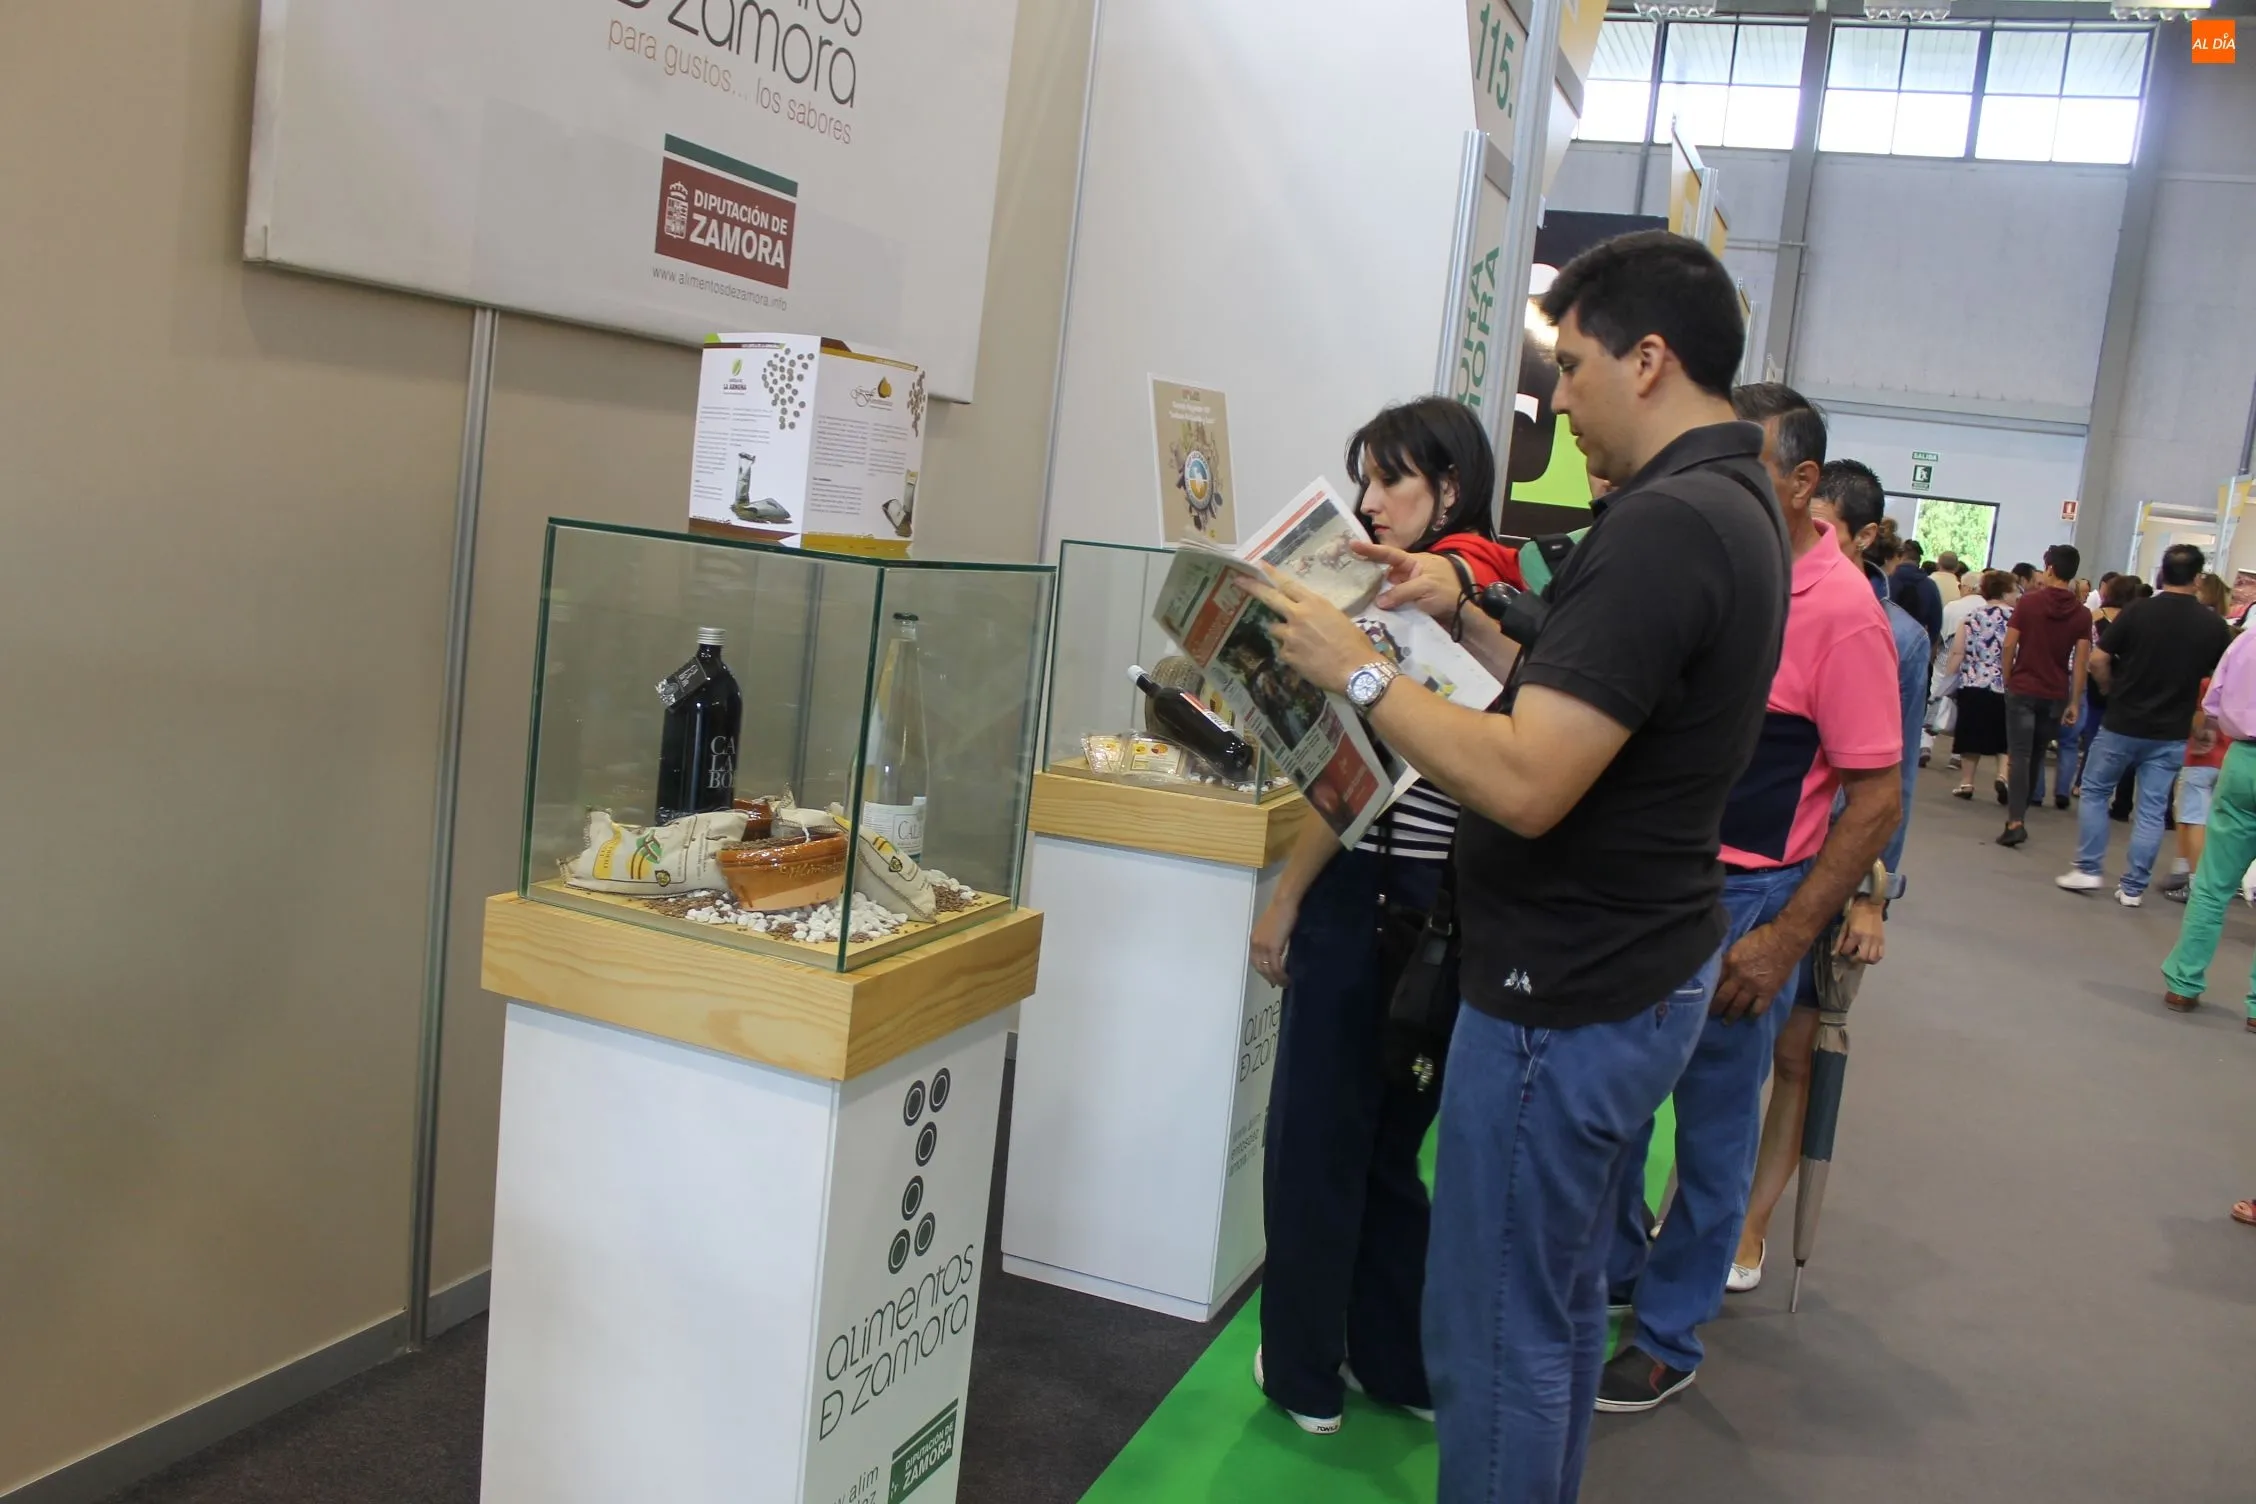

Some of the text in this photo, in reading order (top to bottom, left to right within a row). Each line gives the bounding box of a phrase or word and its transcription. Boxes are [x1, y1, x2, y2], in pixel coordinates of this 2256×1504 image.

[608, 18, 657, 61] para
[756, 77, 781, 114] los
[787, 99, 851, 144] sabores
[694, 189, 788, 235] DIPUTACIÓN DE
[689, 213, 785, 269] ZAMORA
[708, 754, 733, 771] LA
[710, 735, 736, 755] CA
[826, 1244, 974, 1381] alimentos
[851, 1294, 969, 1416] zamora
[903, 1436, 952, 1490] ZAMORA
[905, 1421, 954, 1470] DIPUTACIÓN DE
